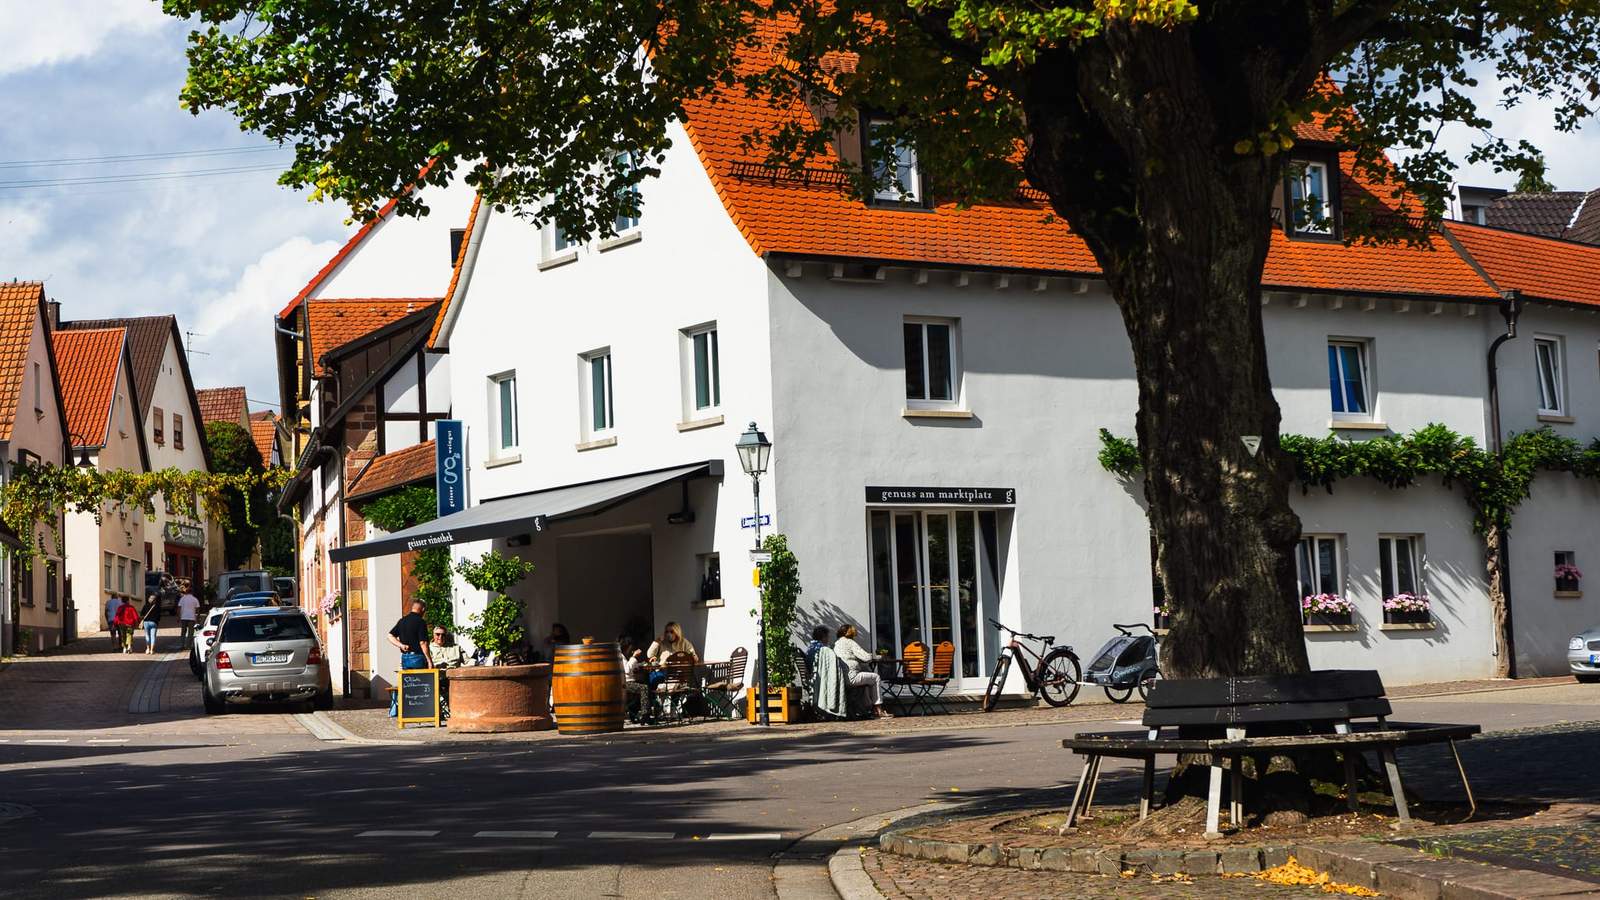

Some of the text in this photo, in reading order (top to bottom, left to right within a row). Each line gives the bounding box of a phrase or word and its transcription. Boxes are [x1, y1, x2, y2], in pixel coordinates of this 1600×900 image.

[881, 489, 993, 502] genuss am marktplatz
[1005, 489, 1013, 502] g
[407, 532, 454, 551] geisser vinothek
